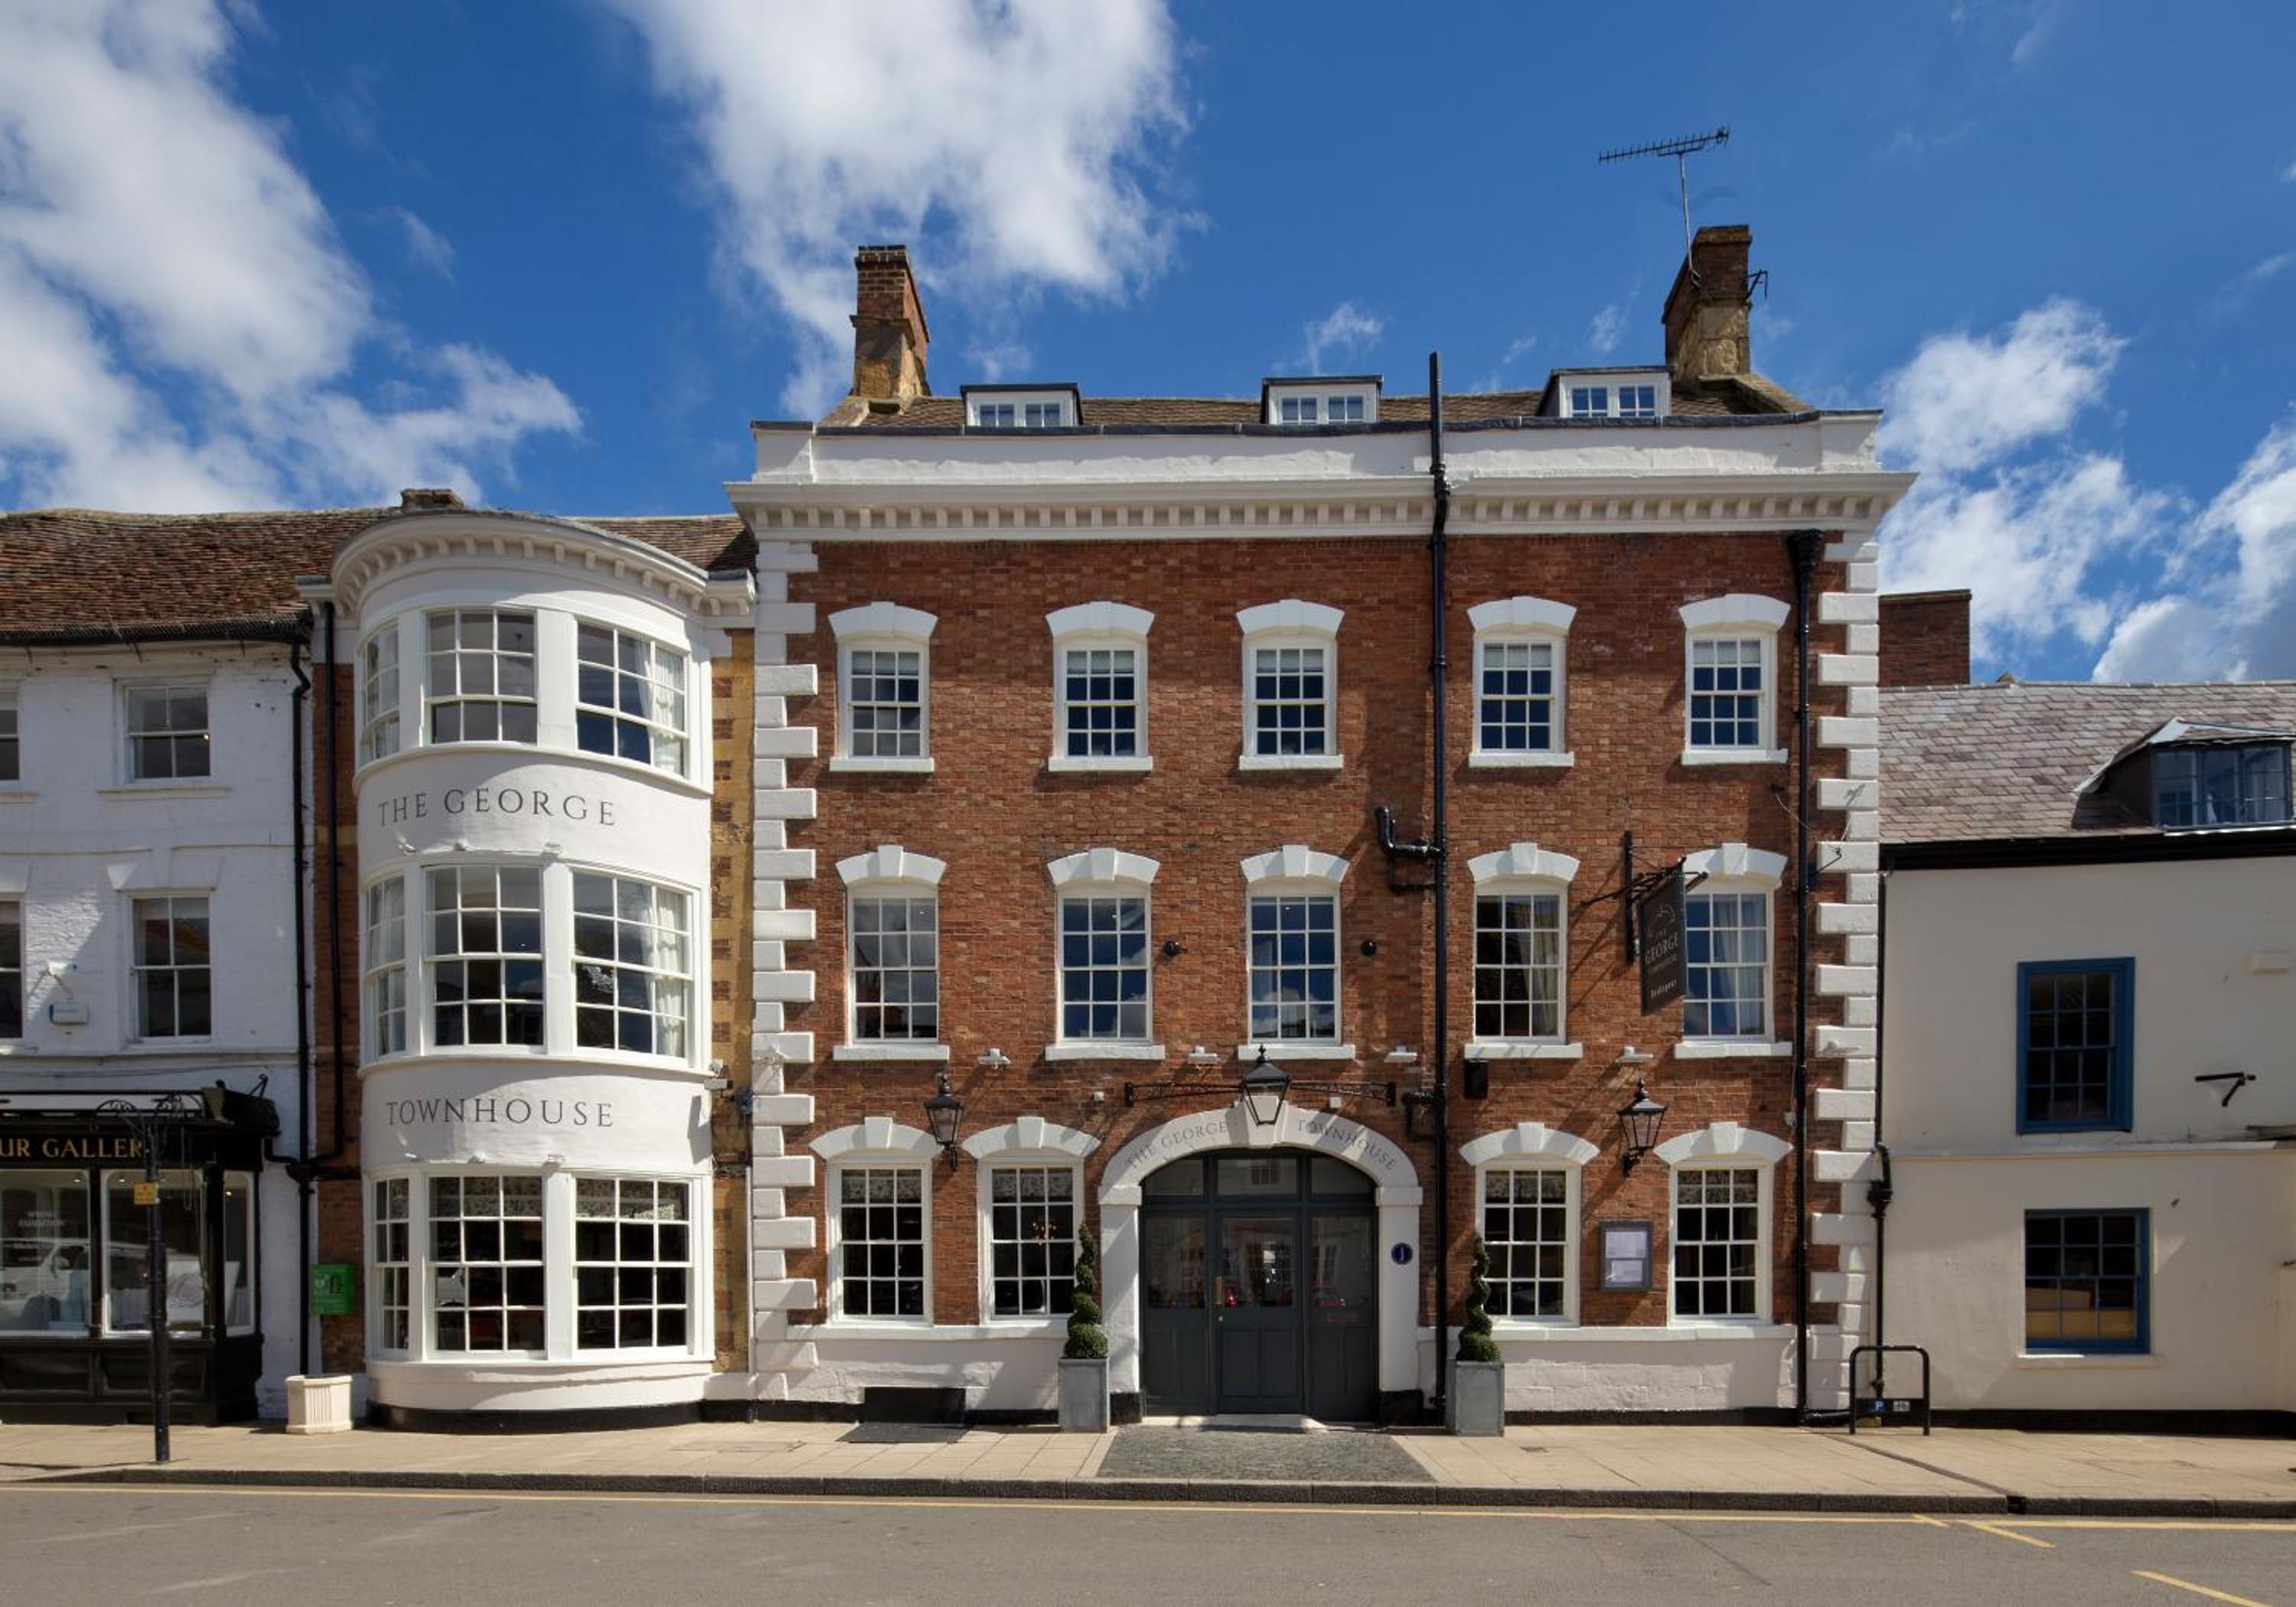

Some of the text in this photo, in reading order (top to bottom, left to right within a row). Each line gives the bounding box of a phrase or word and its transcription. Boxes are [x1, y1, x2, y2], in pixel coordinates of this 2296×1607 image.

[378, 787, 615, 827] THE GEORGE
[1645, 931, 1678, 965] GEORGE
[385, 1097, 614, 1128] TOWNHOUSE
[41, 1137, 144, 1158] GALLER
[1126, 1120, 1397, 1170] THE GEORGE TOWNHOUSE
[1877, 1401, 1883, 1411] P
